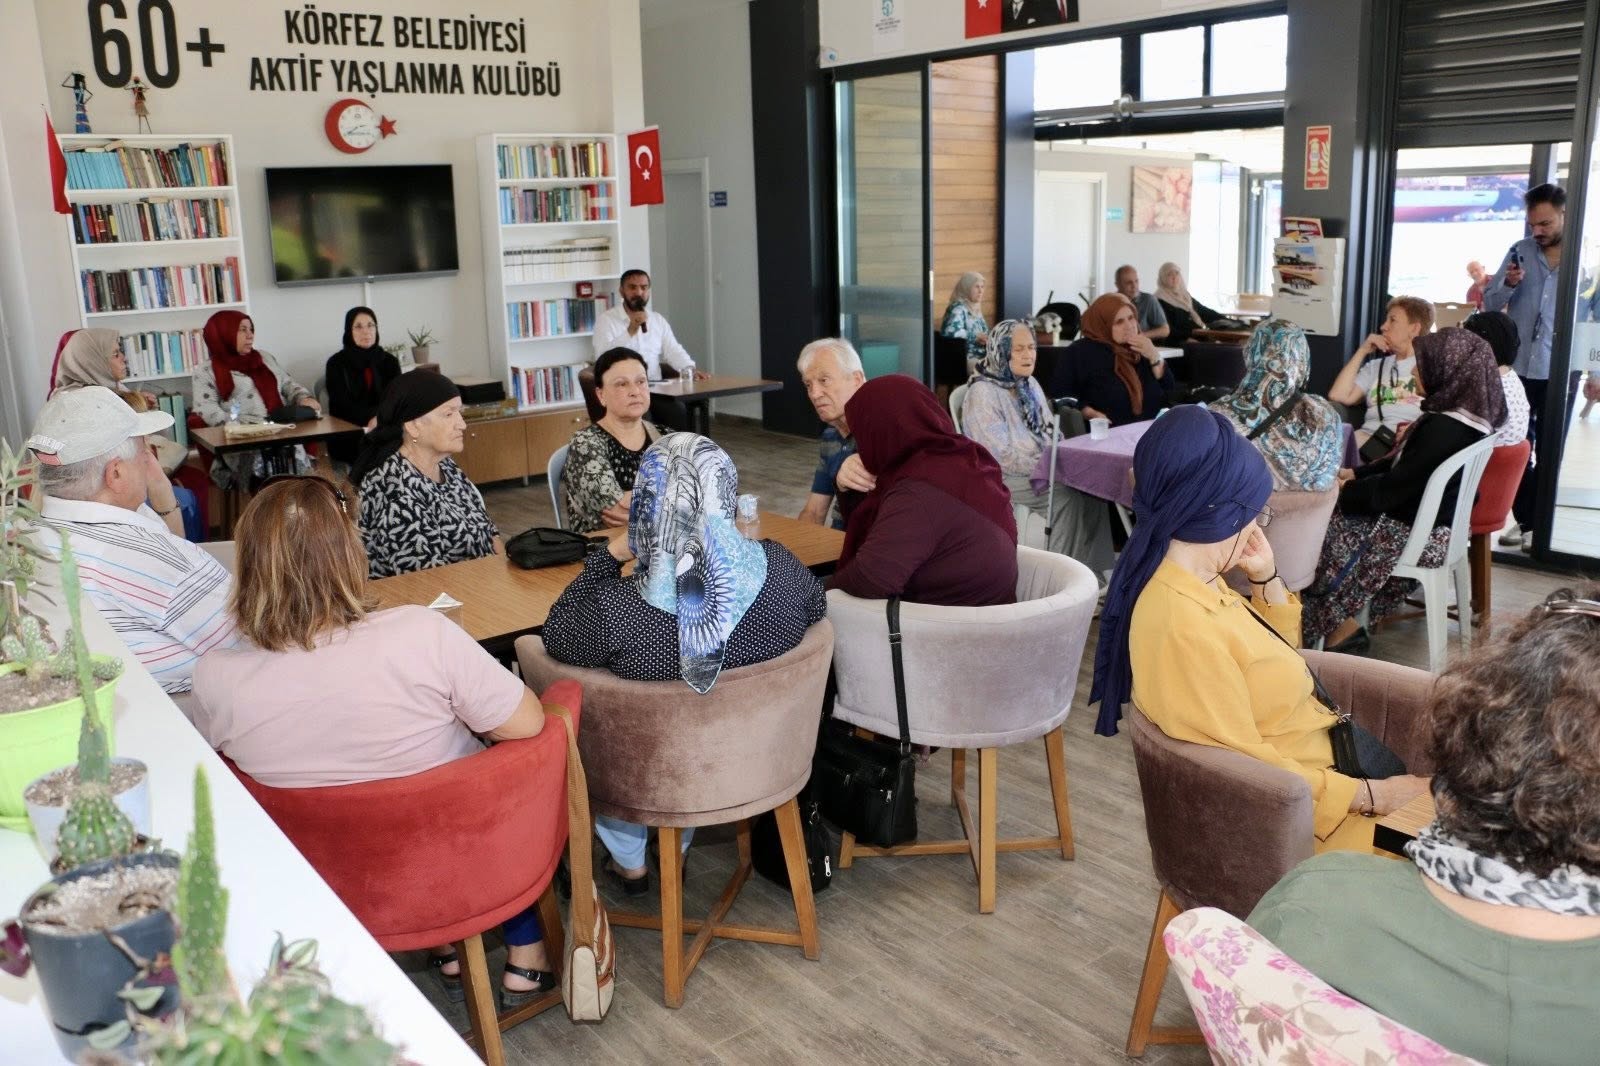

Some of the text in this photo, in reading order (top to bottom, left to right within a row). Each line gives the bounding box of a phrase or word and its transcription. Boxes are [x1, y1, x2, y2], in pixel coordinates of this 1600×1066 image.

[87, 0, 225, 89] 60+
[284, 4, 526, 54] KÖRFEZ BELEDİYESİ
[249, 53, 561, 99] AKTİF YAŞLANMA KULÜBÜ
